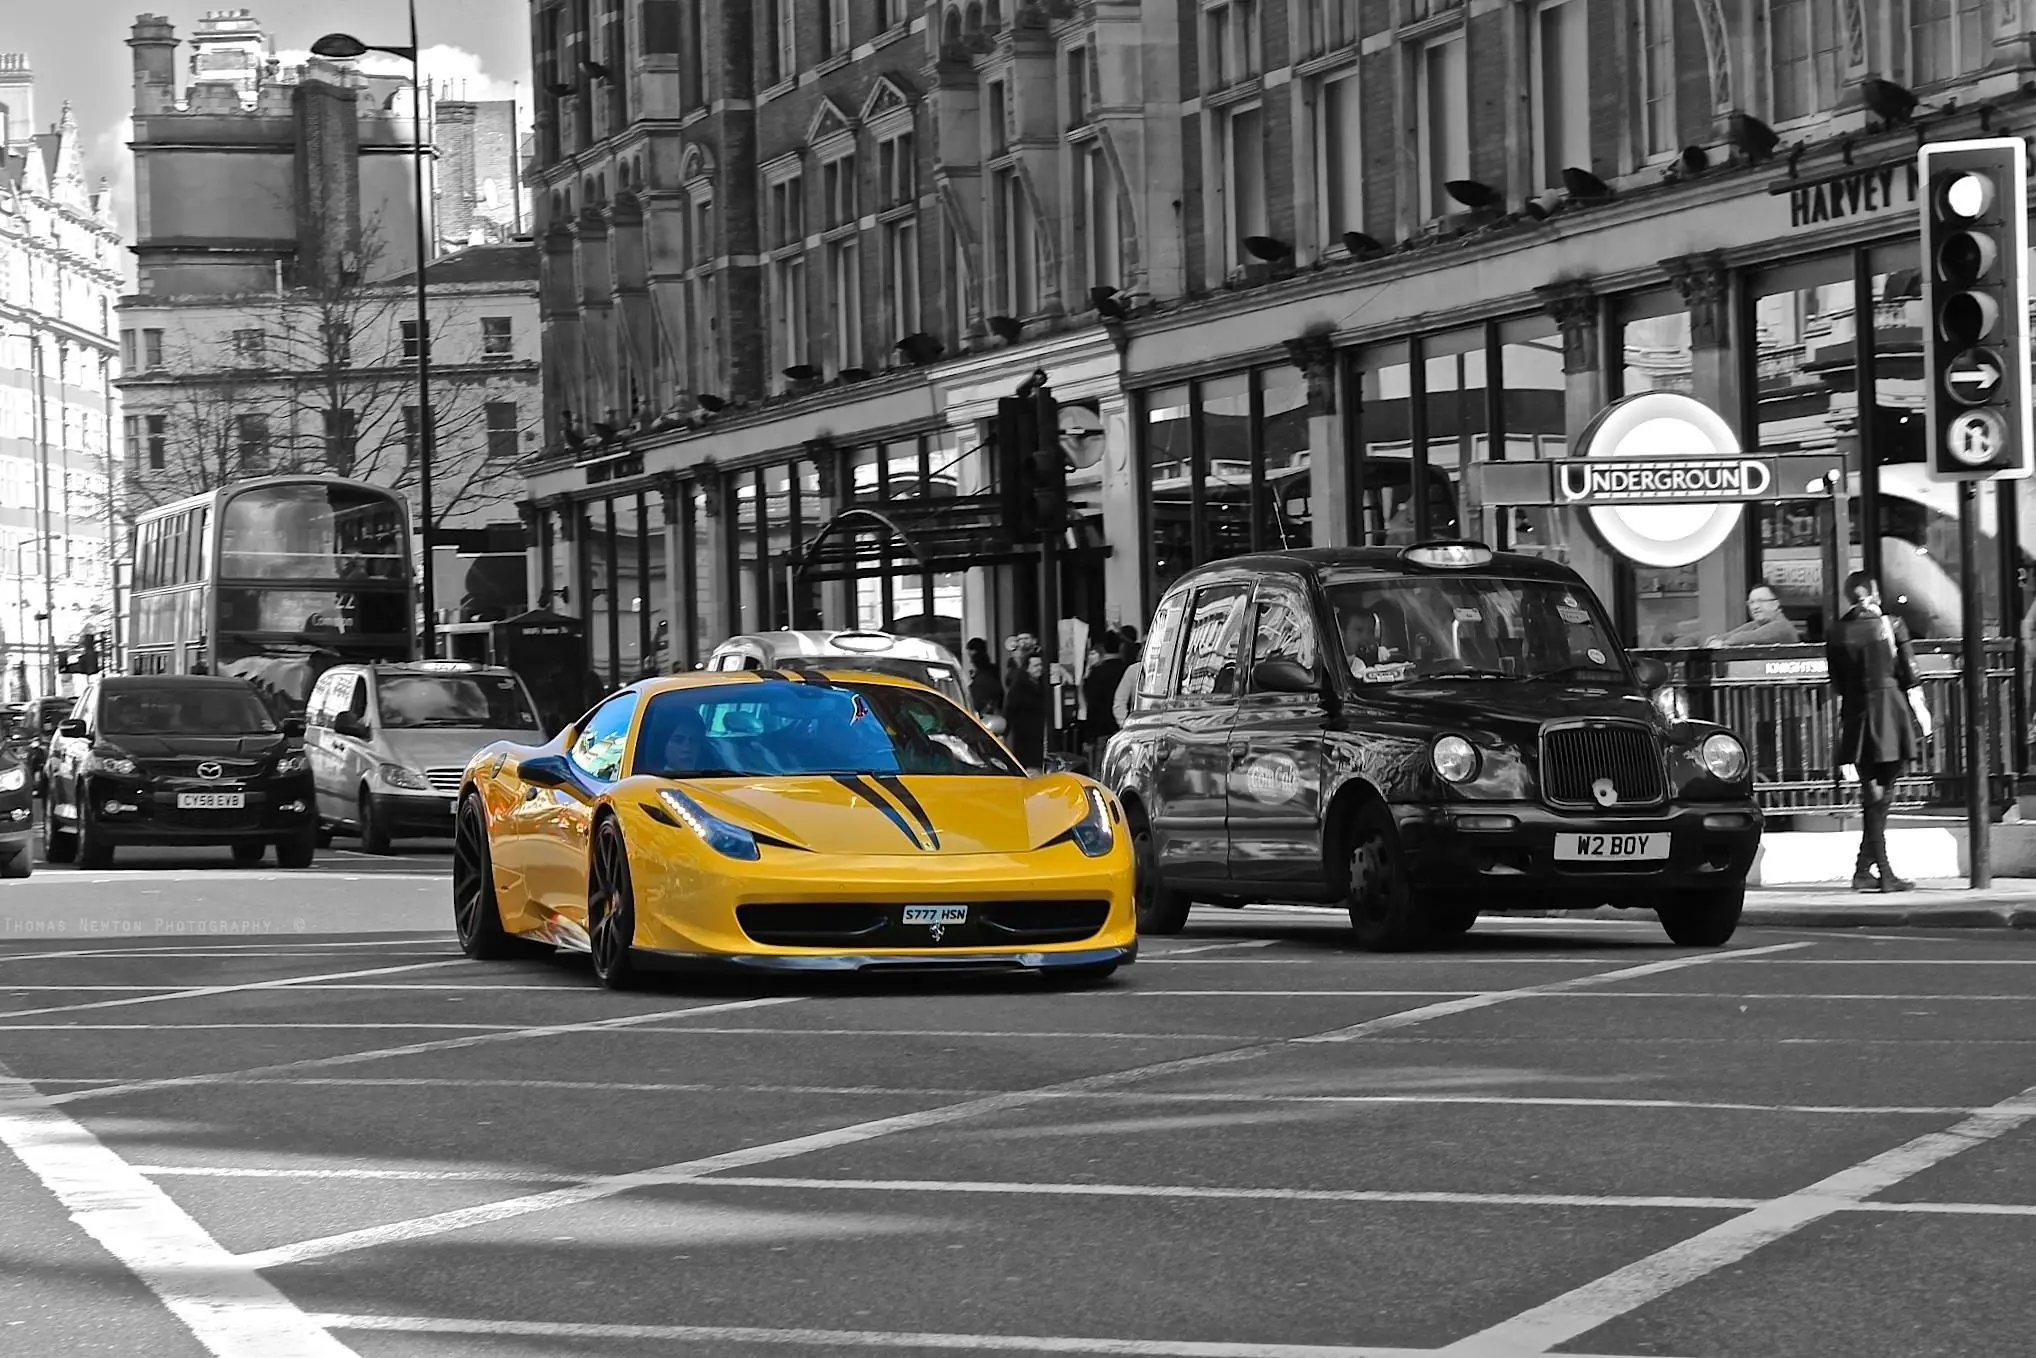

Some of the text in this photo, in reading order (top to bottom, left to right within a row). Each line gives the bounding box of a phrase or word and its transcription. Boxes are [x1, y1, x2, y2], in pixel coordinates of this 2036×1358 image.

[1790, 168, 1893, 227] HARVEY
[1560, 459, 1771, 500] UNDERGROUND
[1426, 547, 1479, 562] TAXI
[1577, 835, 1649, 855] W2 BOY
[905, 909, 965, 920] S777 HSN
